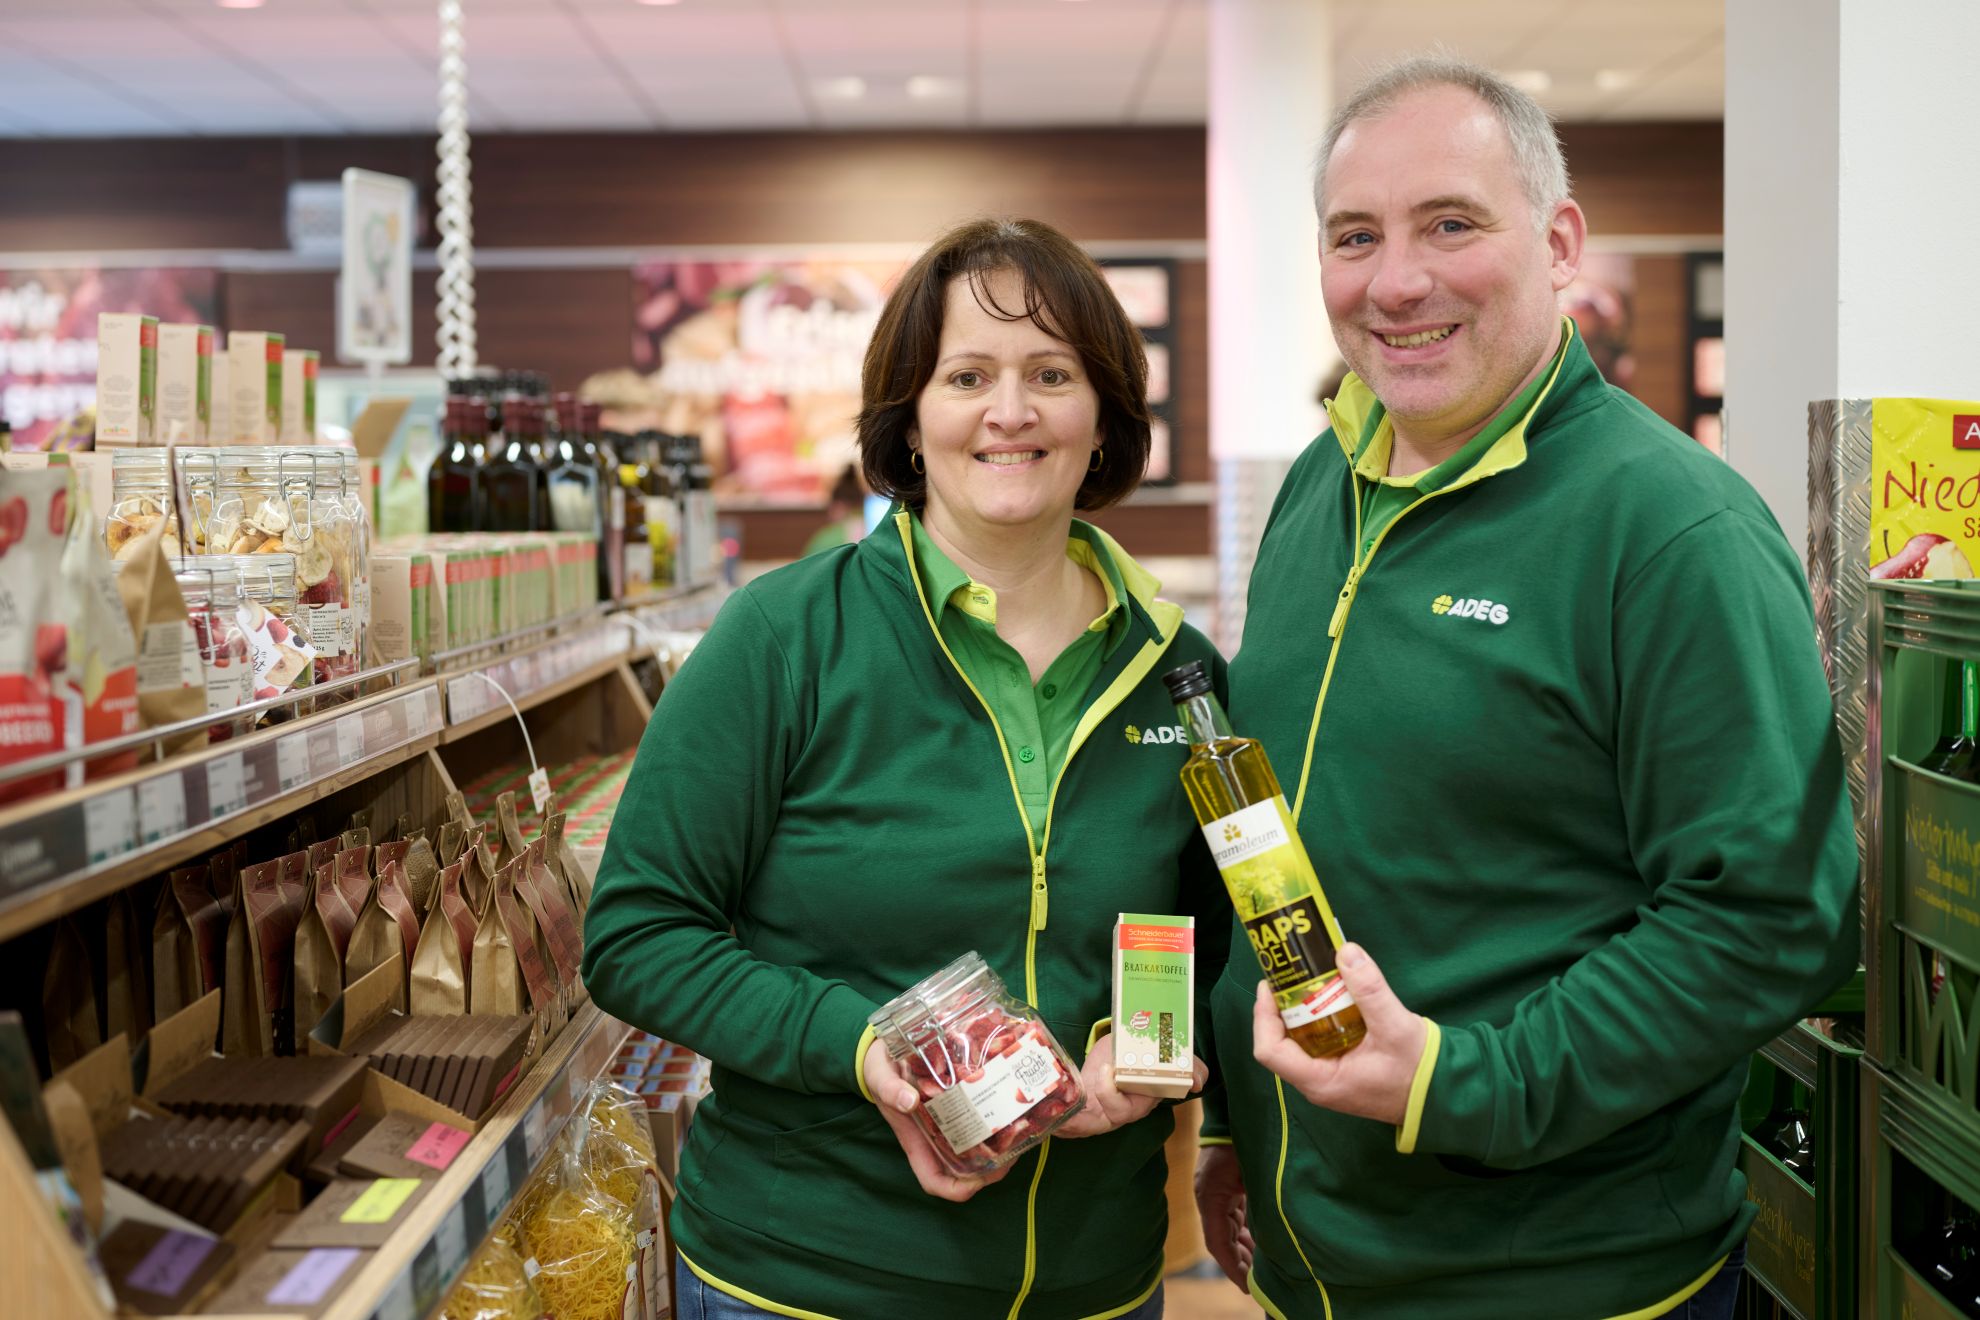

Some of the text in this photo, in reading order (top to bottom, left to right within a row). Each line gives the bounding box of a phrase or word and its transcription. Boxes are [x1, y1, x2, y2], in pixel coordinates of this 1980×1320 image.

[1963, 516, 1980, 539] S
[1447, 598, 1509, 625] ADEG
[1214, 828, 1279, 862] ramoleum
[1128, 928, 1185, 939] Schneiderbauer
[1247, 908, 1311, 952] RAPS
[1124, 961, 1188, 976] BRATKARTOFFEL
[1259, 941, 1302, 972] OEL
